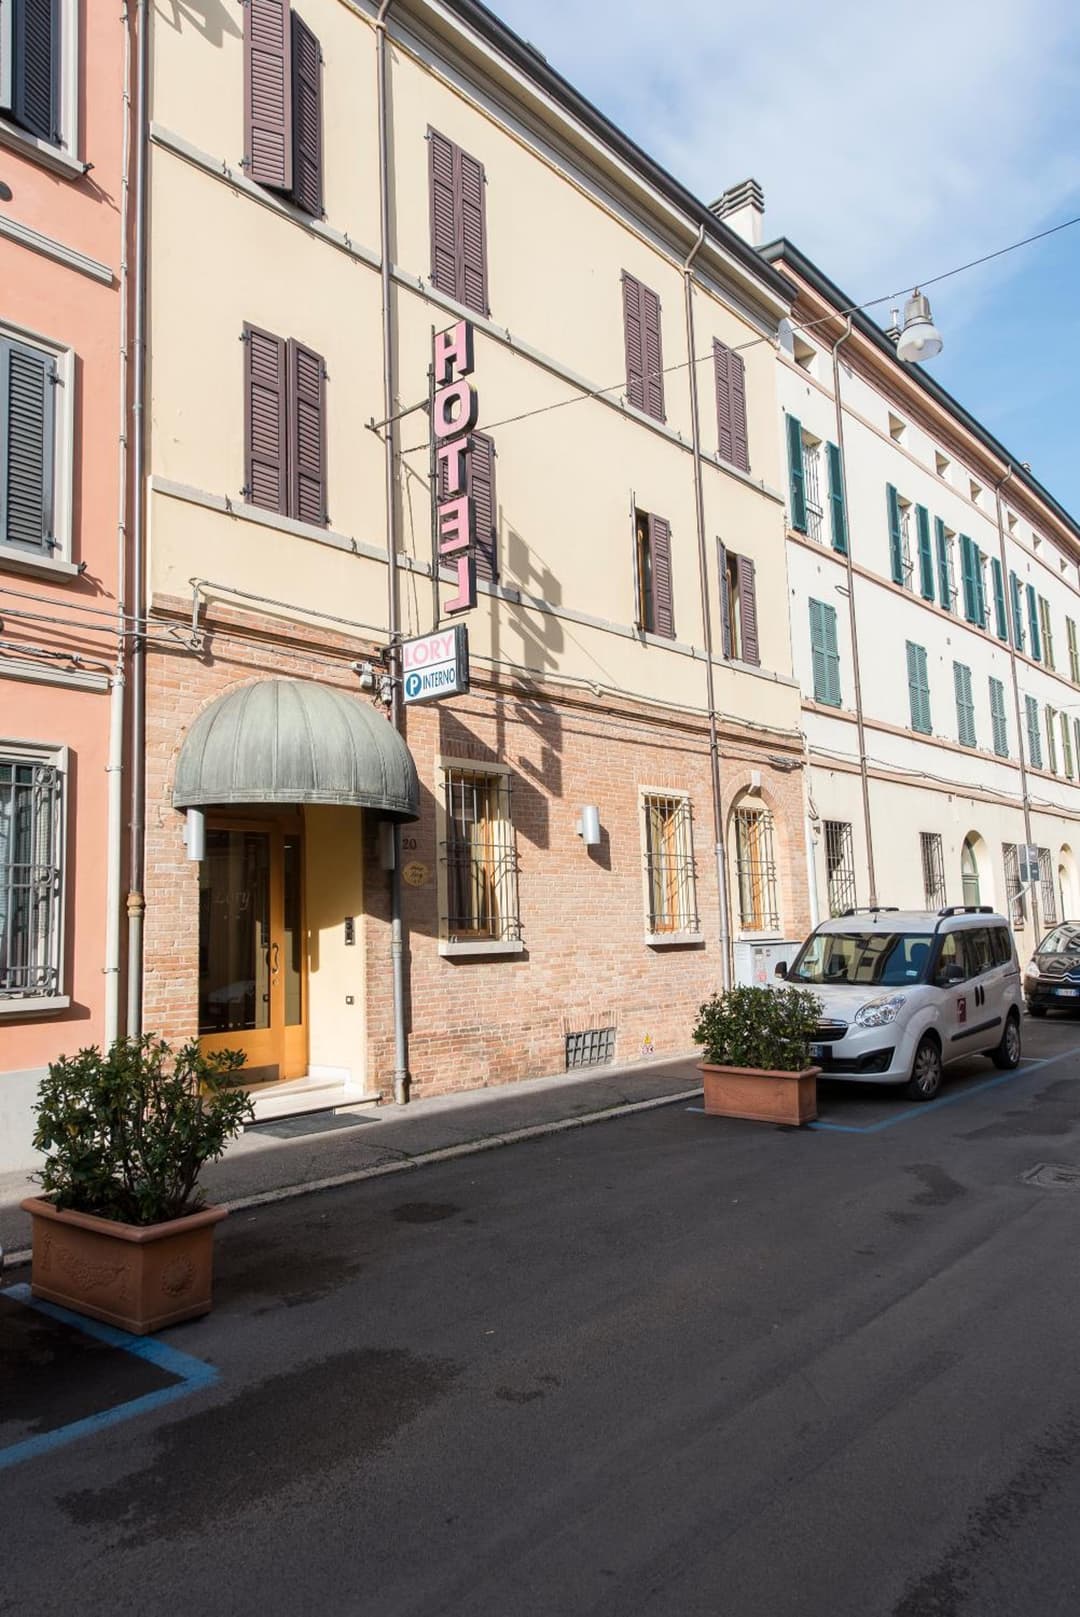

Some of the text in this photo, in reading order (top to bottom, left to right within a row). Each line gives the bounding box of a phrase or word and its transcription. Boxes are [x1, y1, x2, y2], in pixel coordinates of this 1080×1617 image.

[404, 634, 453, 668] LORY
[409, 667, 455, 696] P INTERNO
[402, 838, 417, 850] 20
